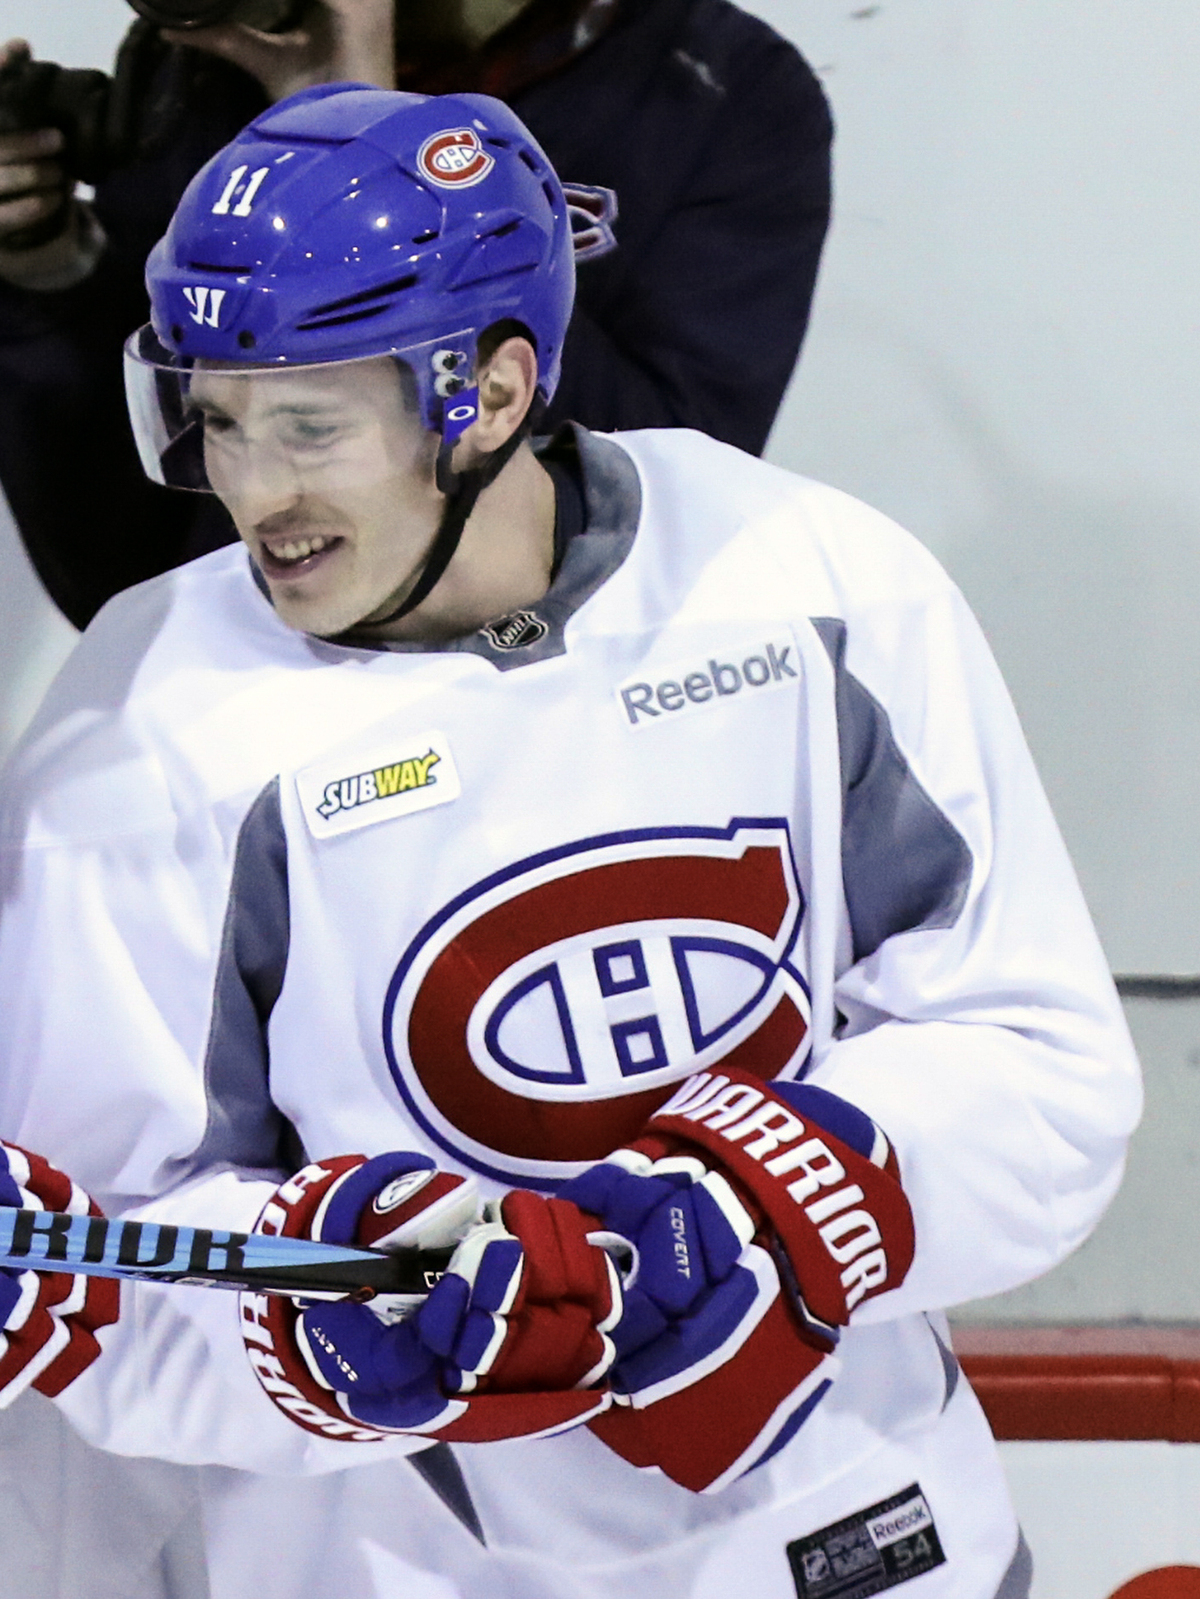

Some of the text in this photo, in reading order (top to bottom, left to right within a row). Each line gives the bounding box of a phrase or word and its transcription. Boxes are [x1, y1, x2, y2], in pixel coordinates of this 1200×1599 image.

[211, 164, 270, 217] 11
[619, 642, 798, 725] Reebok
[315, 747, 442, 821] SUBWAY
[650, 1072, 887, 1312] WARRIOR
[669, 1206, 691, 1280] COVERT
[873, 1506, 927, 1541] Reebok
